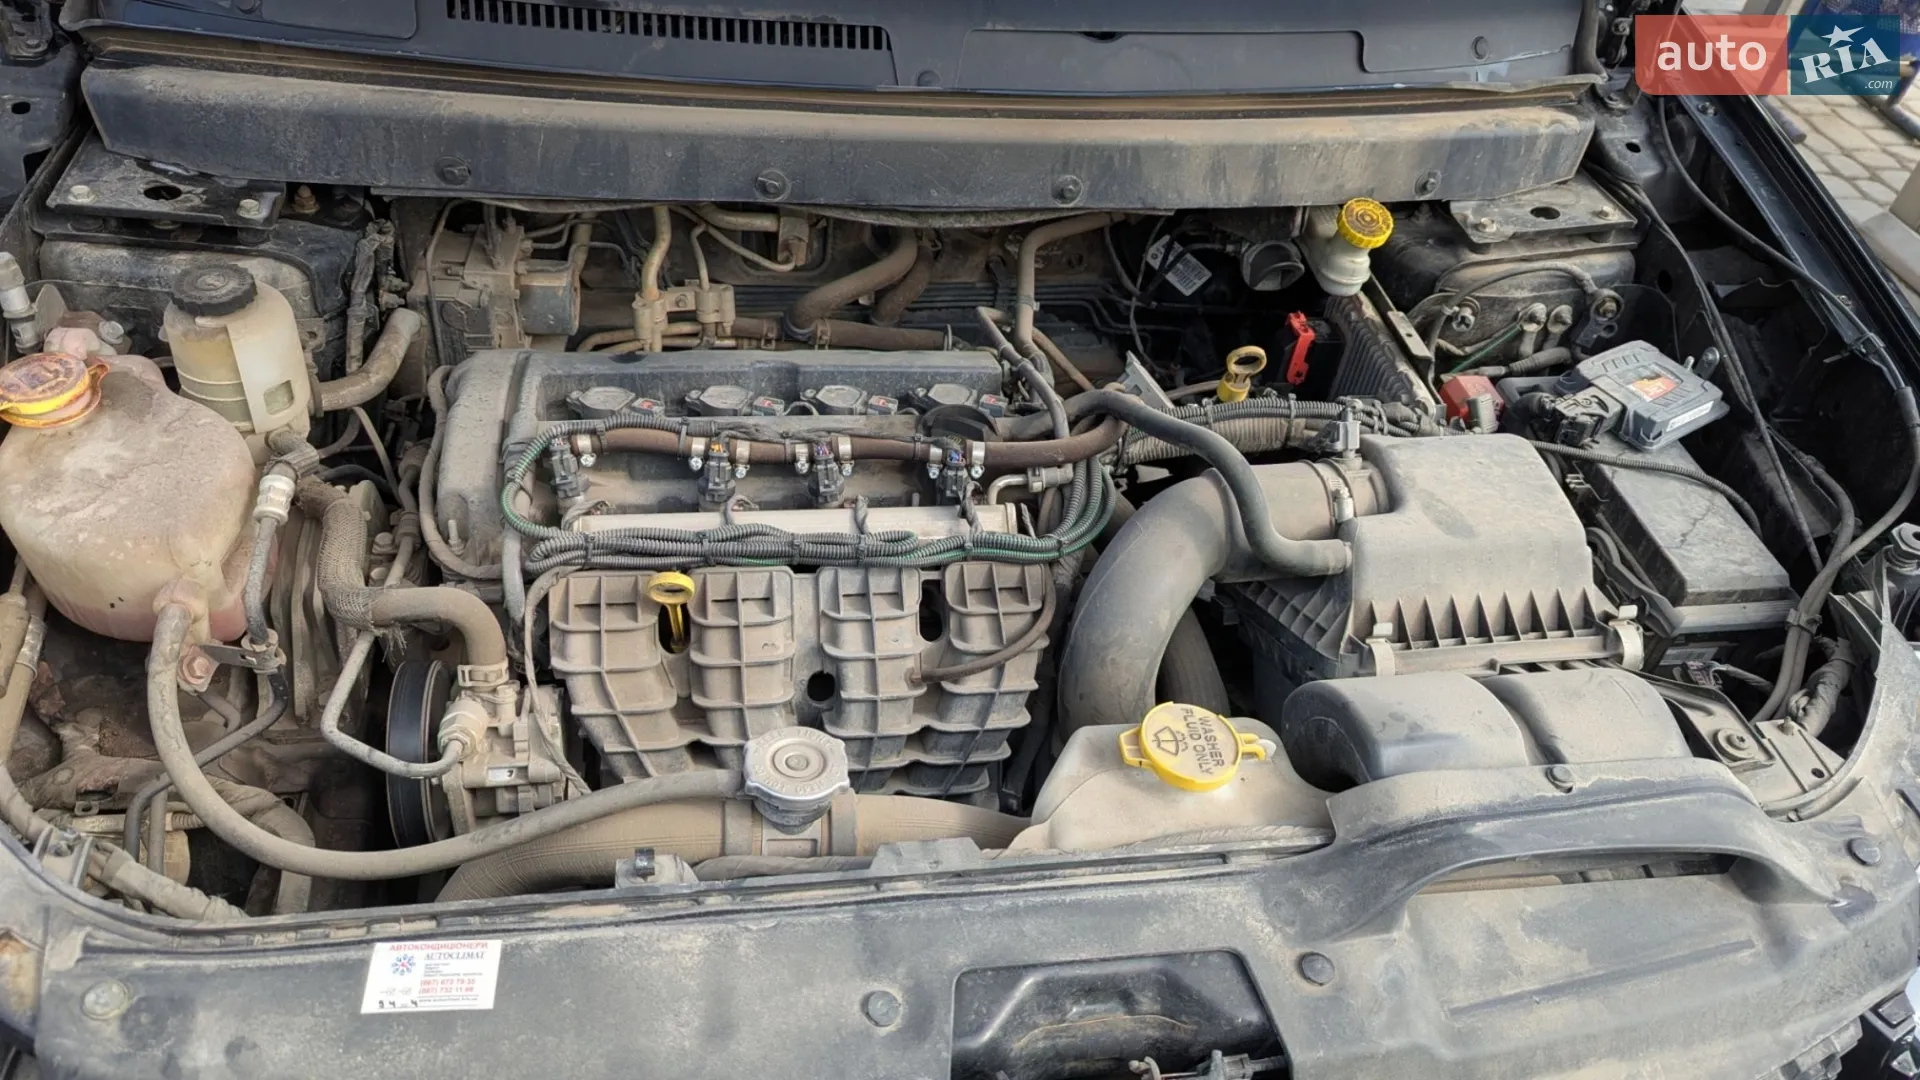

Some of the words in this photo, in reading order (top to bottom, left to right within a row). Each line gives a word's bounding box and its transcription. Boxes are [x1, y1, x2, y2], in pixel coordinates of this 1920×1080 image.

[1181, 708, 1202, 741] FLUID
[1192, 745, 1214, 775] ONLY
[1199, 716, 1225, 767] WASHER
[424, 951, 485, 960] AUTOCLIMAT
